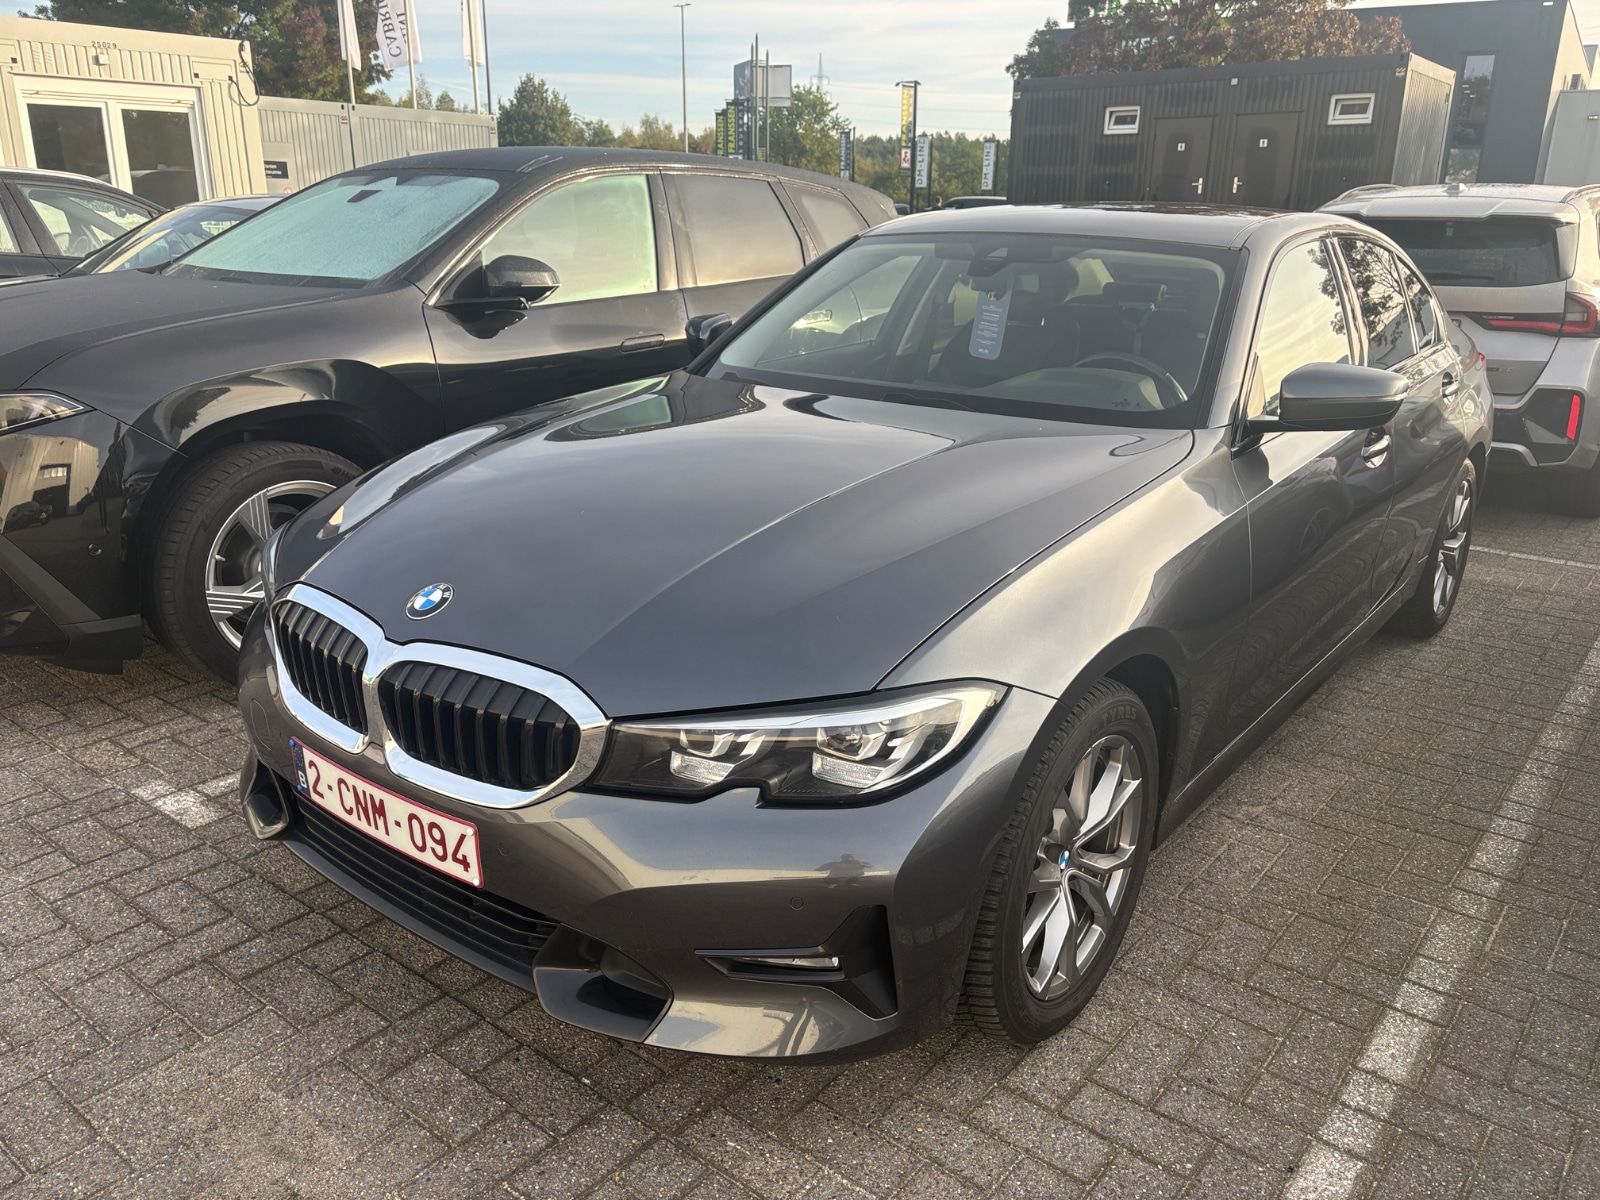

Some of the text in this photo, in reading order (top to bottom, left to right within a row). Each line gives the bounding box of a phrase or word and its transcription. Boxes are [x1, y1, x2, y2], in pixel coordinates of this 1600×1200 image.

[91, 40, 117, 49] 25029
[917, 138, 925, 185] DM-LINE
[982, 144, 992, 188] DM-LINE
[1102, 705, 1137, 727] TYRES
[298, 772, 308, 789] B
[308, 760, 471, 872] 2-CNM-094
